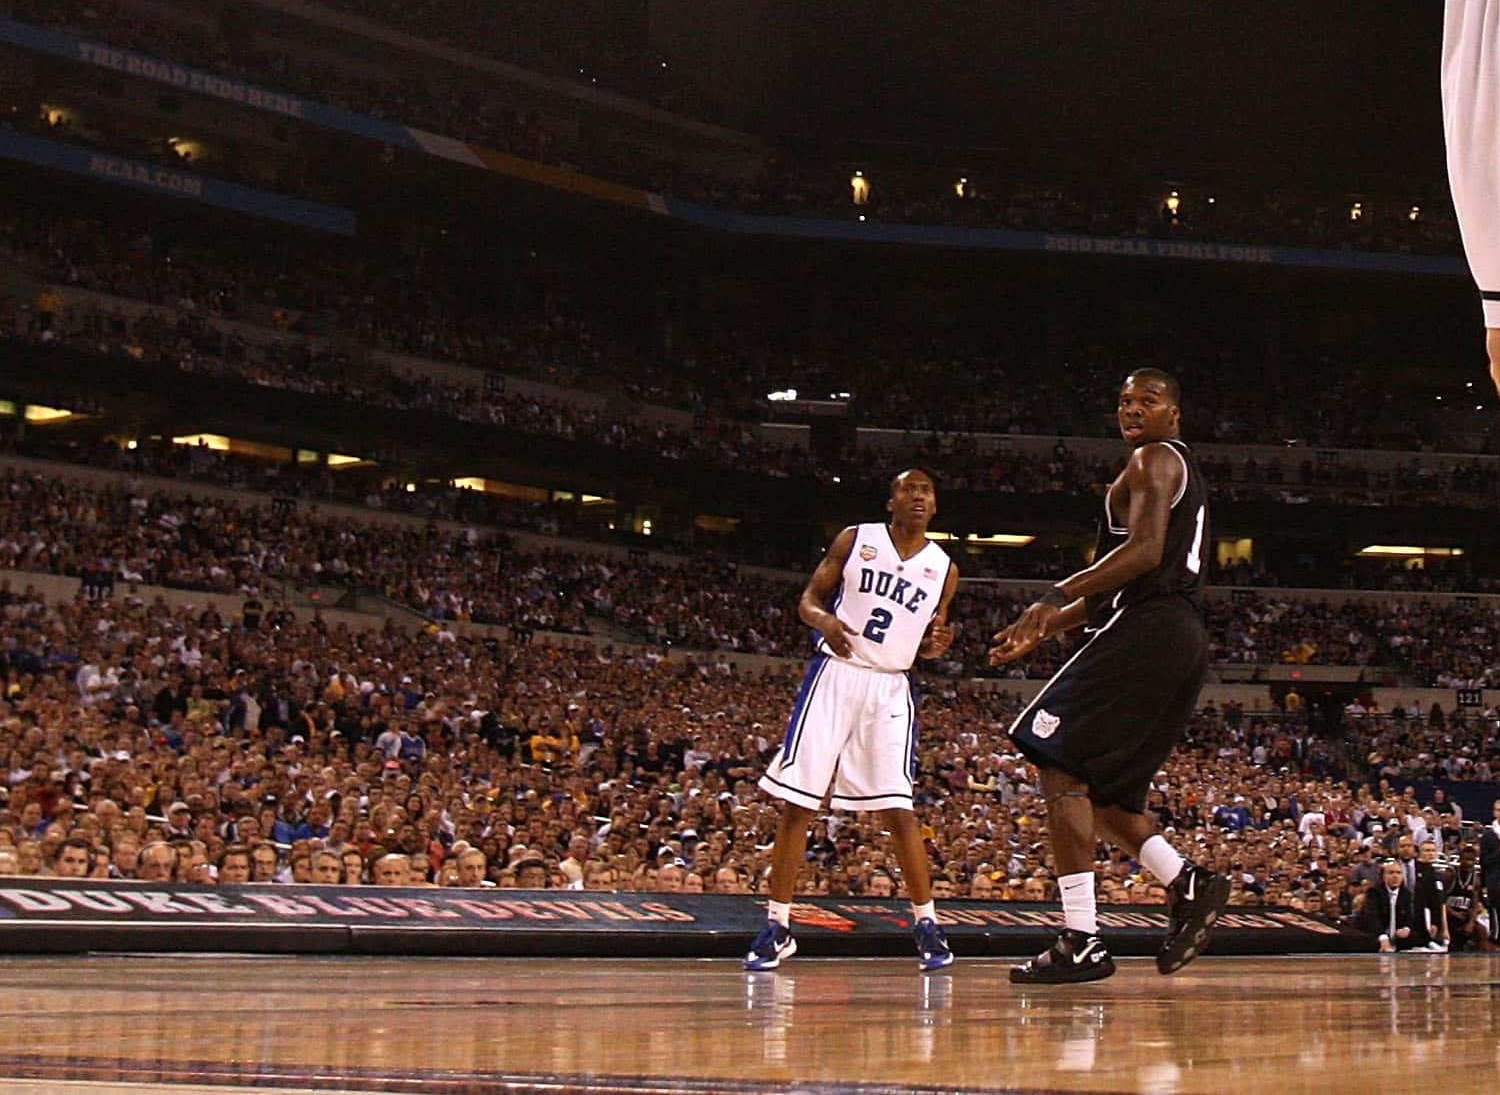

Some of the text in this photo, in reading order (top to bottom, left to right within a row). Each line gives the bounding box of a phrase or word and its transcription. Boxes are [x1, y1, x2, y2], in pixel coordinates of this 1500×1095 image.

[126, 54, 186, 86] ROAD
[1186, 504, 1206, 576] 1
[858, 567, 928, 614] DUKE
[862, 607, 894, 644] 2
[0, 888, 696, 921] DUKE BLUE DEVILS
